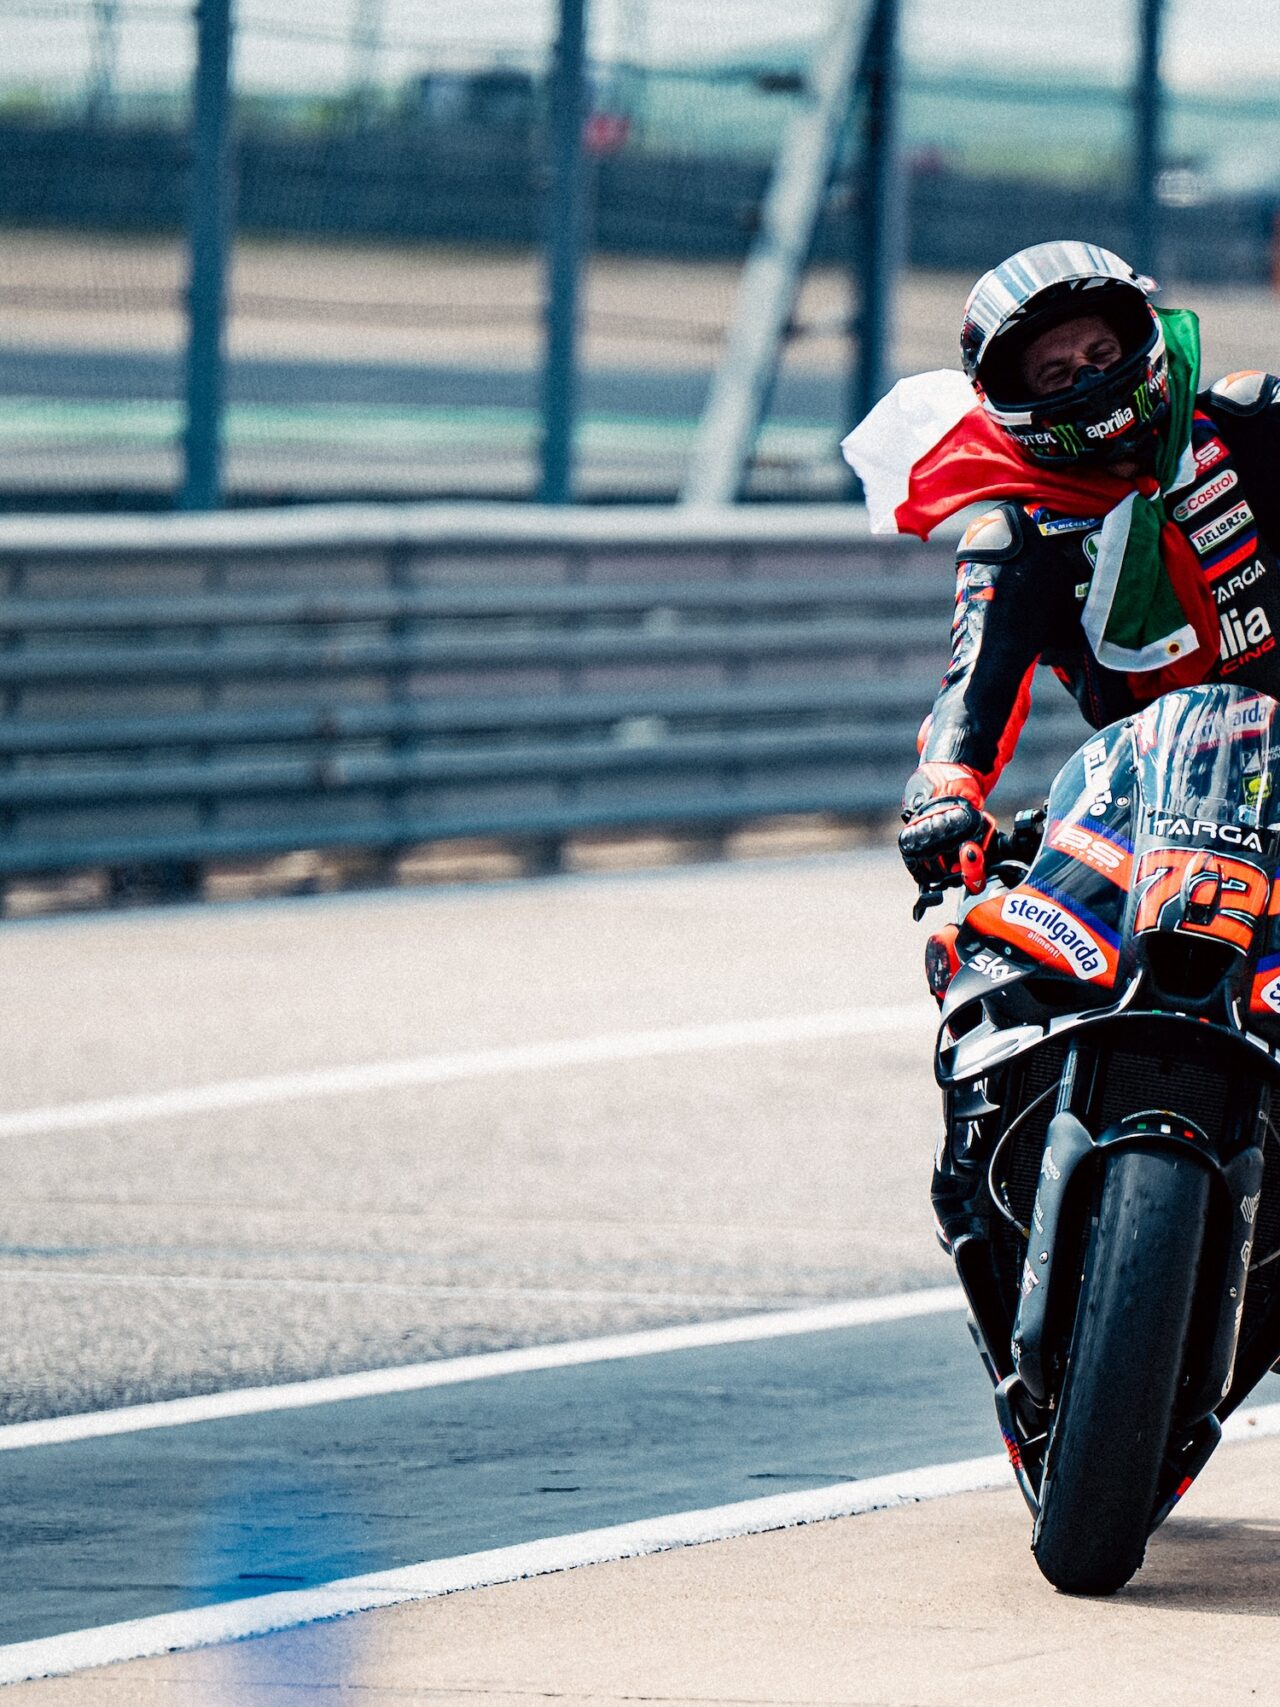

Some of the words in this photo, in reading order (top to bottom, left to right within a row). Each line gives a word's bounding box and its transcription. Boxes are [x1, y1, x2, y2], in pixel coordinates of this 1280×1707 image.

[1085, 407, 1134, 439] aprilia
[1187, 473, 1233, 510] Castrol
[1197, 511, 1247, 547] DELLORTO
[1212, 560, 1266, 604] ARGA
[1219, 636, 1276, 676] CING
[1054, 826, 1125, 868] BS
[1153, 819, 1262, 853] TARGA
[1132, 846, 1270, 957] 72
[1008, 900, 1099, 972] sterilgarda
[1027, 931, 1060, 959] alimenti
[968, 954, 1021, 984] sky
